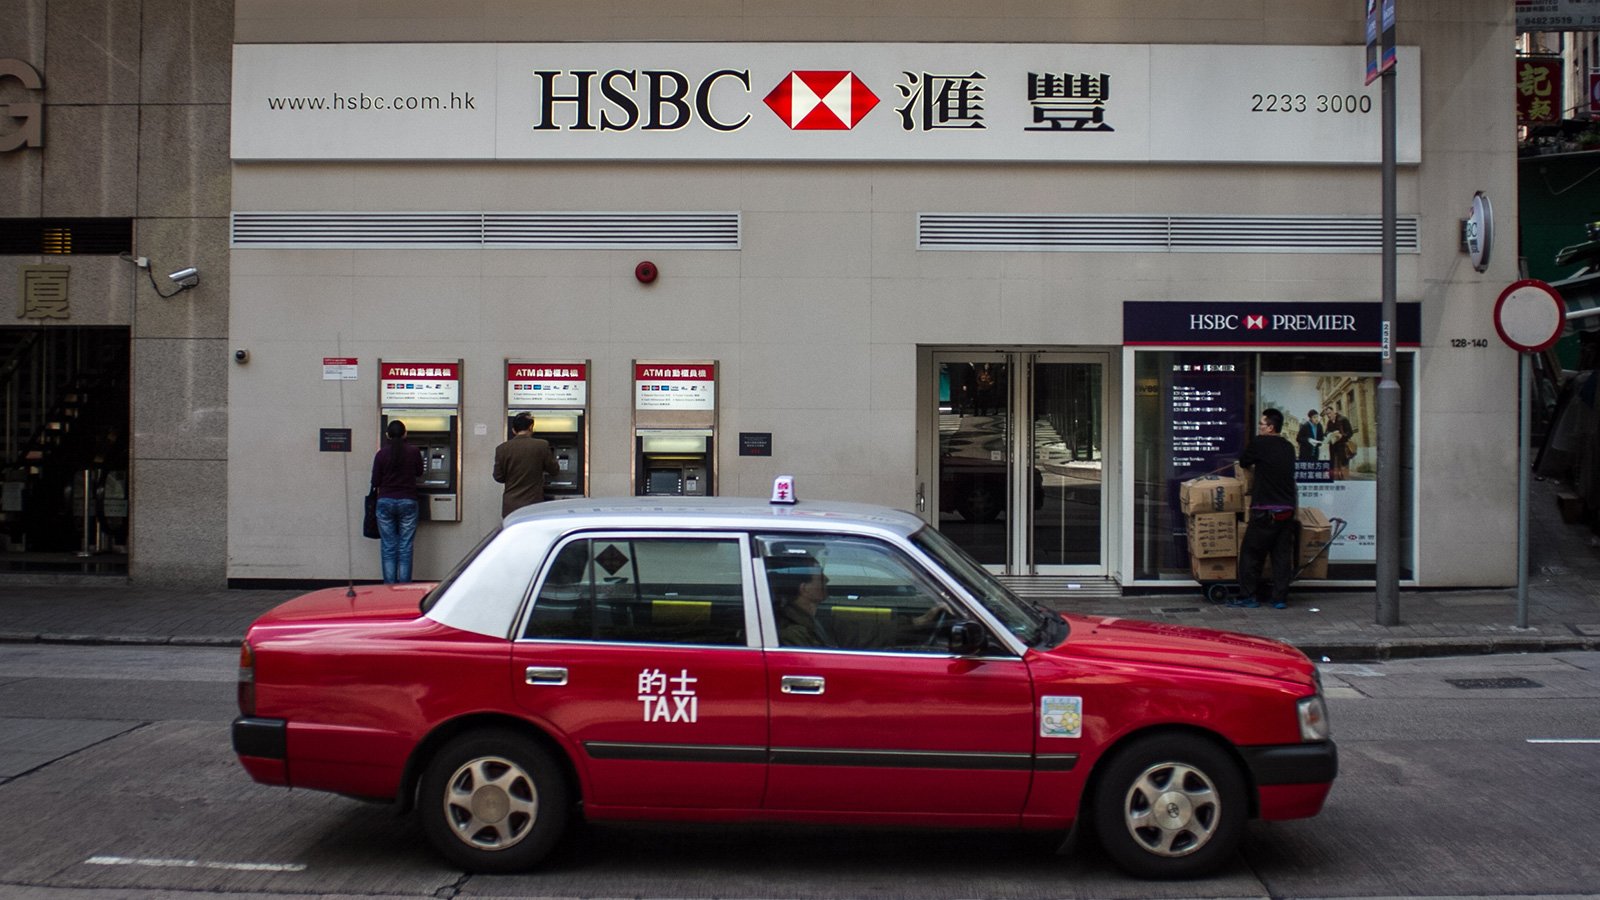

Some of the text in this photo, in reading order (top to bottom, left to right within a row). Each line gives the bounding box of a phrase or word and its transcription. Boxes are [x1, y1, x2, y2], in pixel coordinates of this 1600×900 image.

[268, 92, 475, 111] www.hsbc.com.hk
[533, 69, 752, 132] HSBC
[1251, 94, 1372, 113] 2233 3000
[1190, 314, 1357, 331] HSBC PREMIER
[1451, 338, 1488, 348] 128-140
[638, 668, 698, 695] 的士
[637, 695, 697, 723] TAXI
